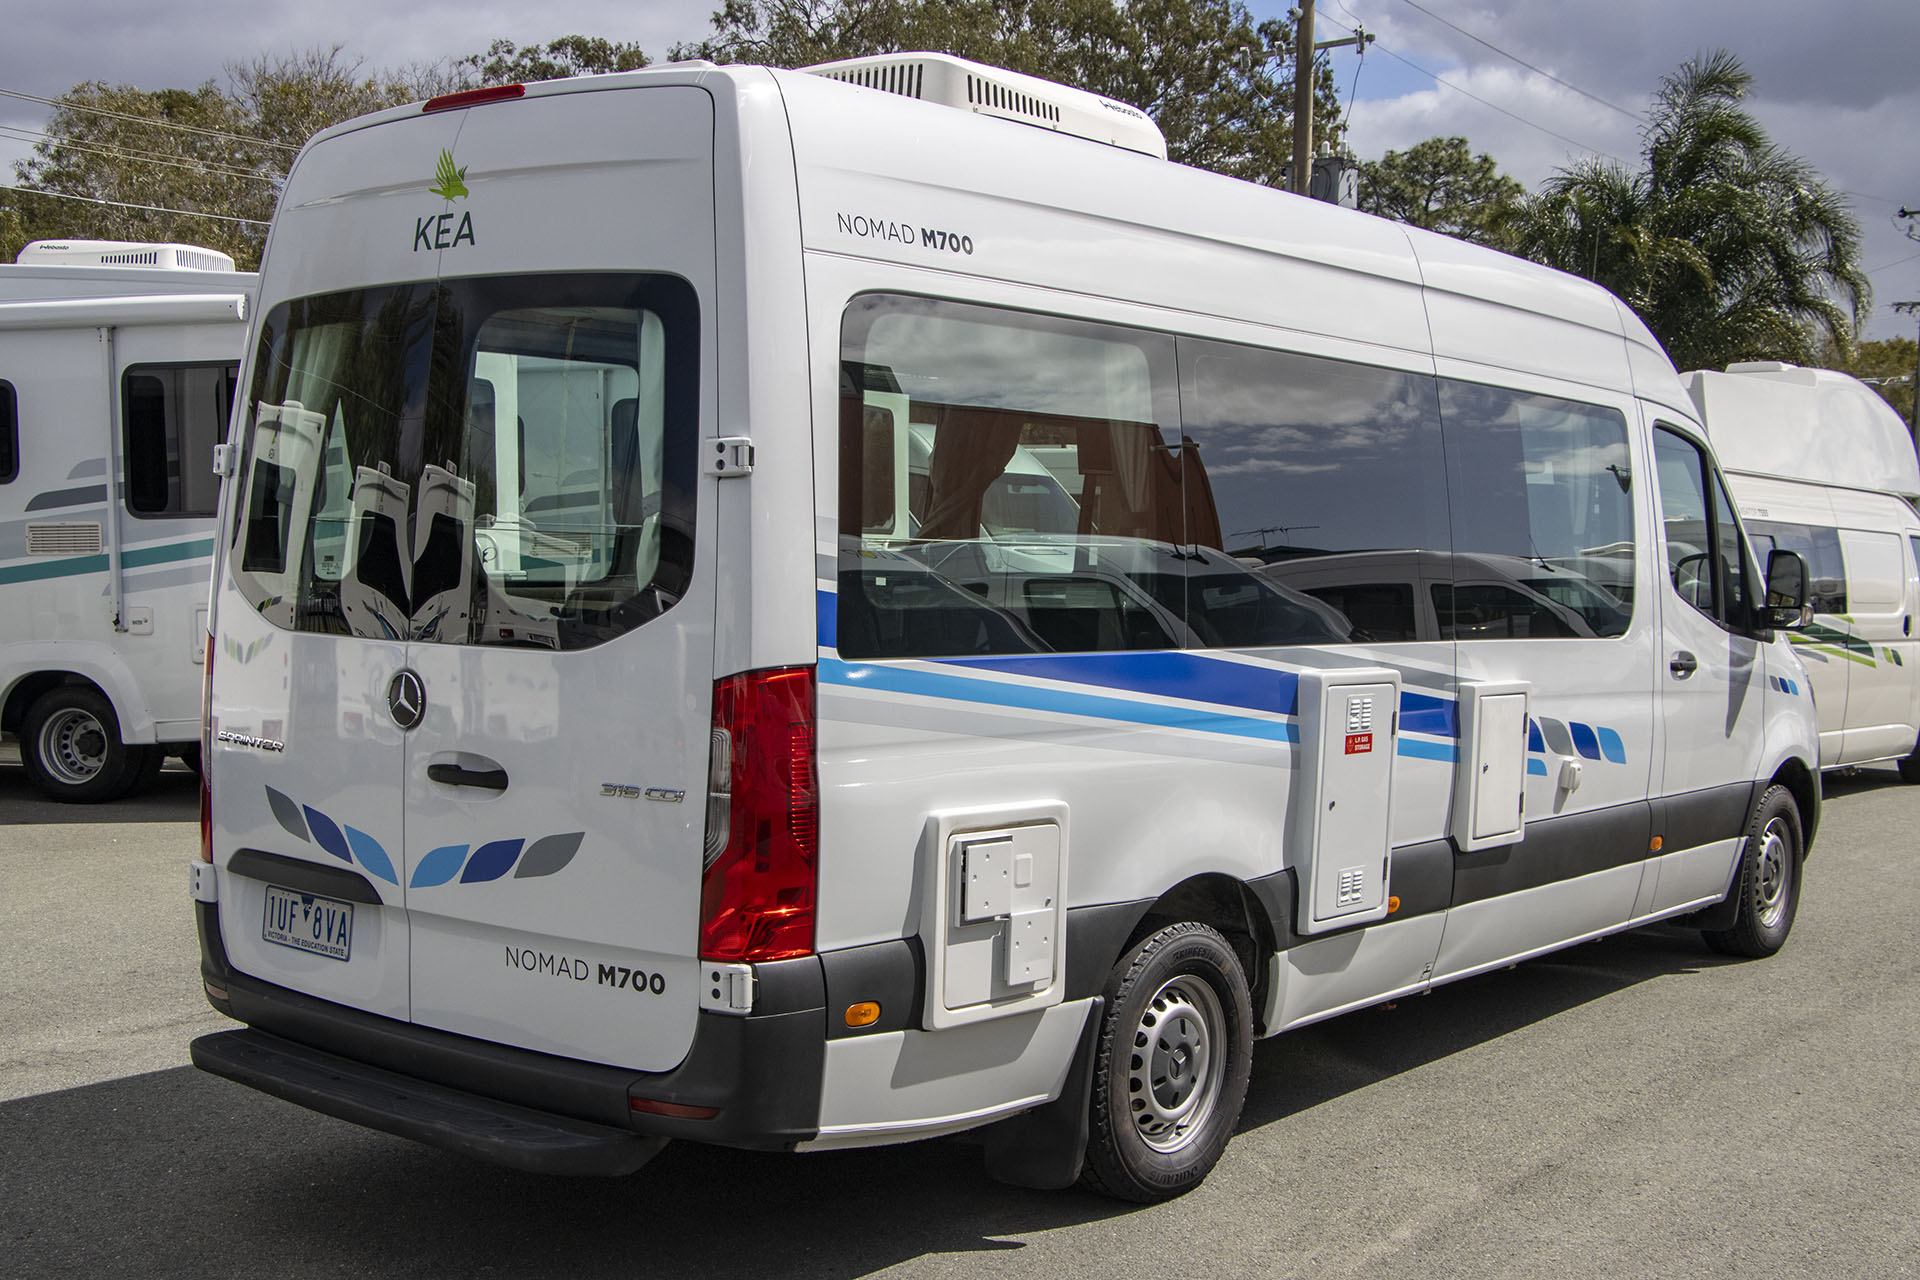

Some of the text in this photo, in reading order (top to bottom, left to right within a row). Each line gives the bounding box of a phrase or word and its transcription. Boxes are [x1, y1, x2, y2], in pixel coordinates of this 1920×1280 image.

[413, 210, 475, 252] KEA
[837, 212, 974, 255] NOMAD M700
[218, 730, 285, 753] SPRINTER
[644, 787, 686, 803] CDI
[270, 895, 347, 948] 1UF 8VA
[268, 930, 288, 942] VICTORIA
[291, 936, 301, 946] THE
[301, 939, 329, 953] EDUCATION
[329, 946, 345, 957] STATE
[505, 946, 666, 995] NOMAD M700
